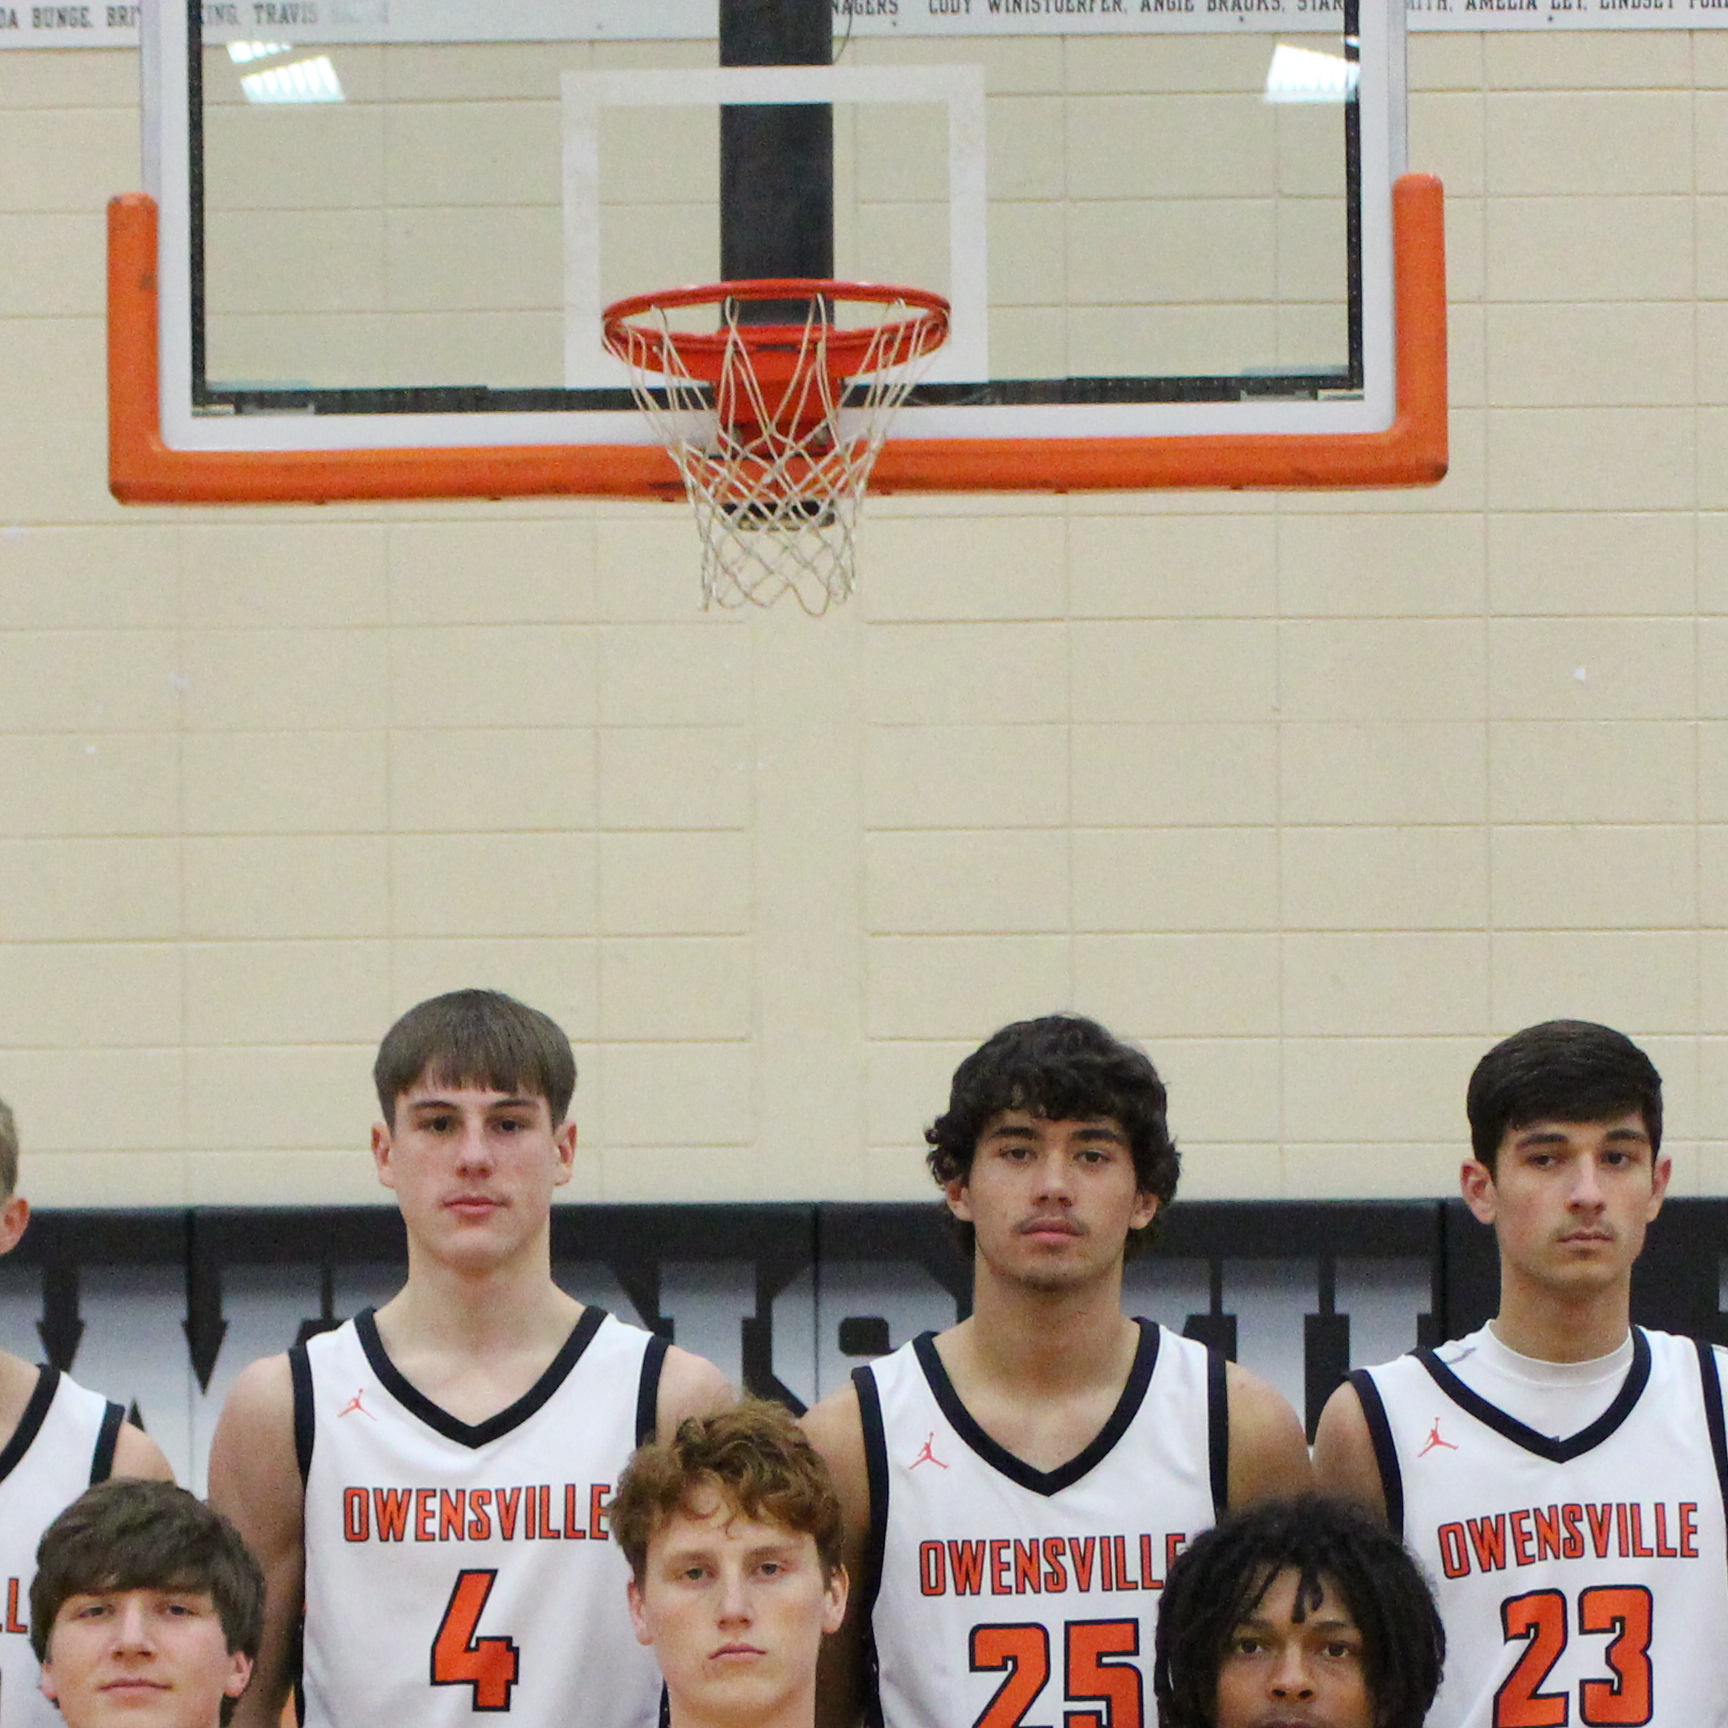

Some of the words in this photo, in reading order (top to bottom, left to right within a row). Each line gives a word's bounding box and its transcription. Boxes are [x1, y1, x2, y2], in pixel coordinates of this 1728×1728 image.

[343, 1483, 611, 1542] OWENSVILLE
[1437, 1502, 1699, 1579] OWENSVILLE
[430, 1568, 520, 1712] 4
